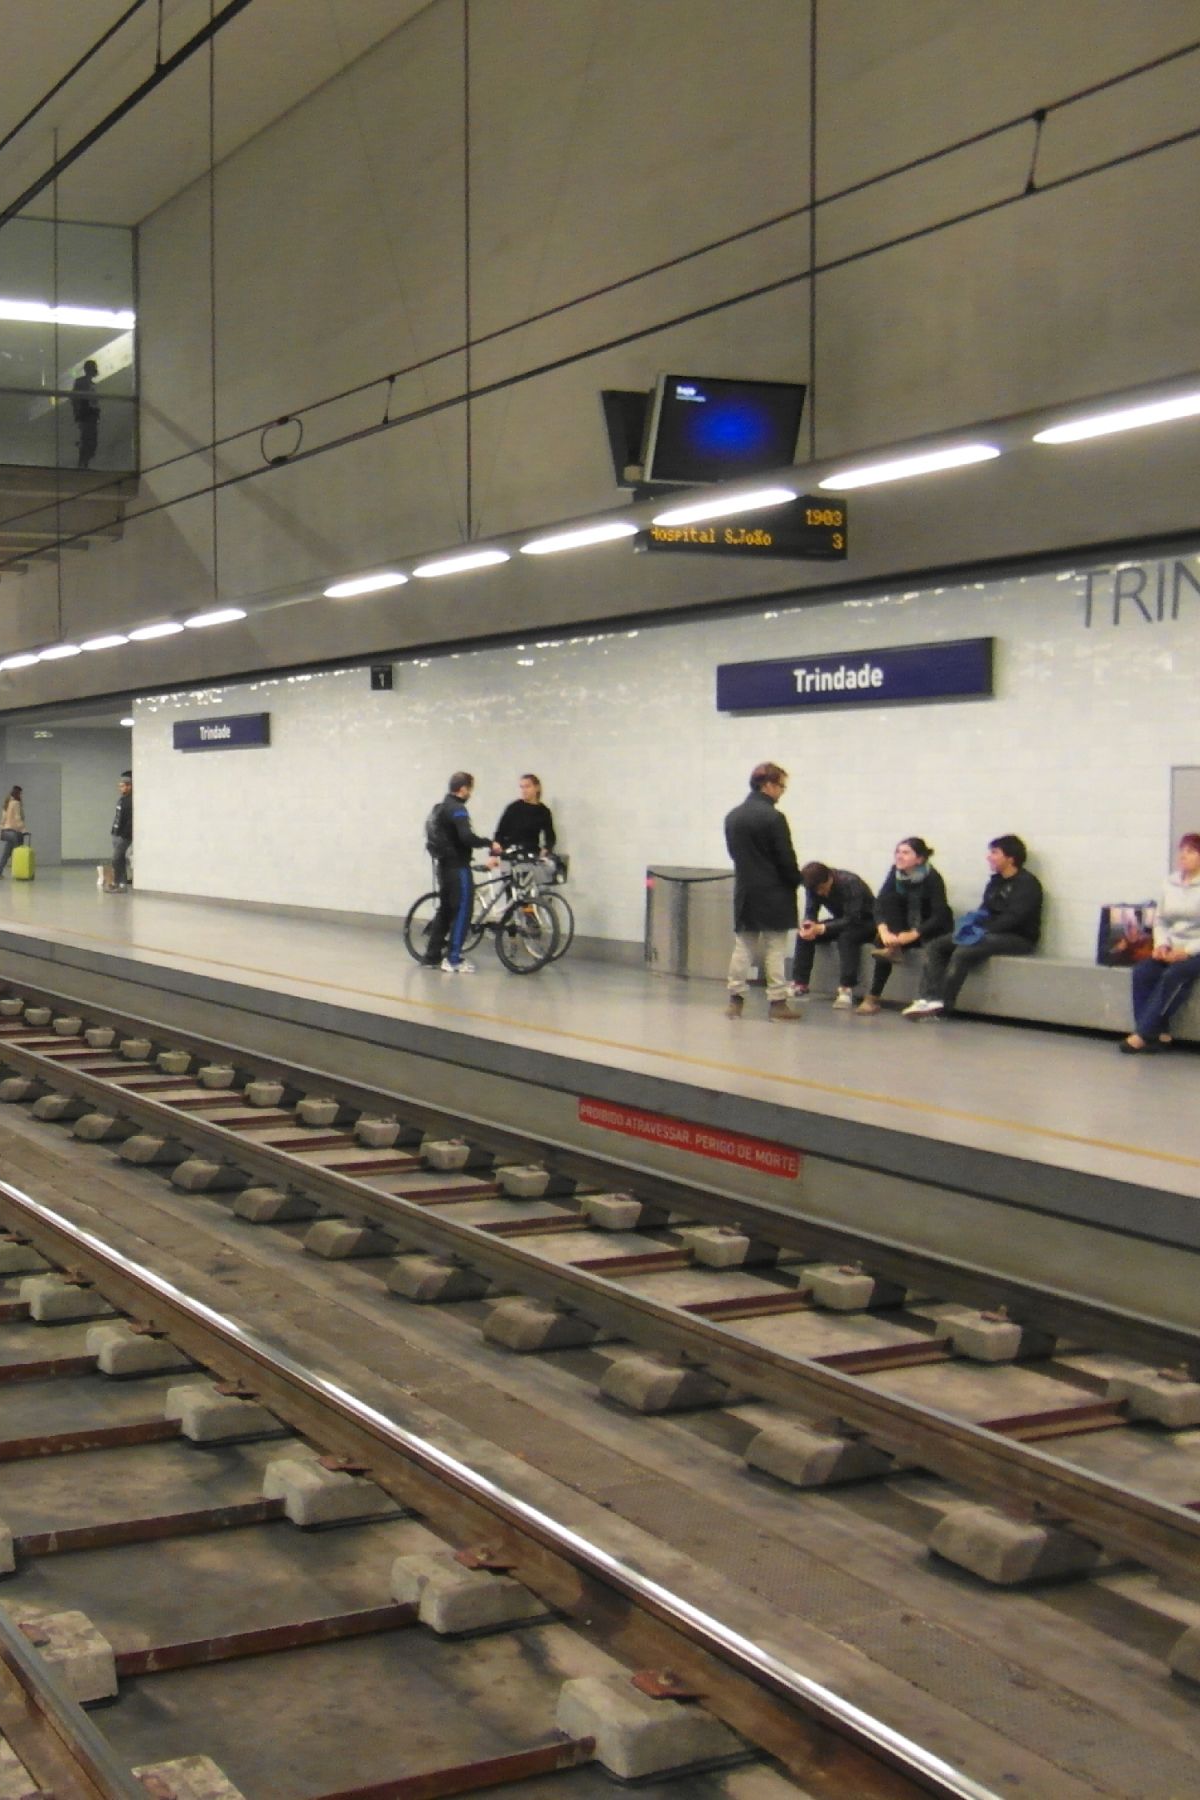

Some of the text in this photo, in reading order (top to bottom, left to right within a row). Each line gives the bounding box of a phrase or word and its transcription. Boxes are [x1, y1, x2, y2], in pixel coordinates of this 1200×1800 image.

[832, 533, 844, 549] 3
[379, 672, 385, 687] 1
[793, 663, 884, 693] Trindade
[199, 724, 231, 741] Trindade
[580, 1103, 624, 1127] PROIBIDO
[695, 1133, 735, 1156] PERIGO
[737, 1144, 752, 1161] DE
[755, 1149, 797, 1173] MORTE
